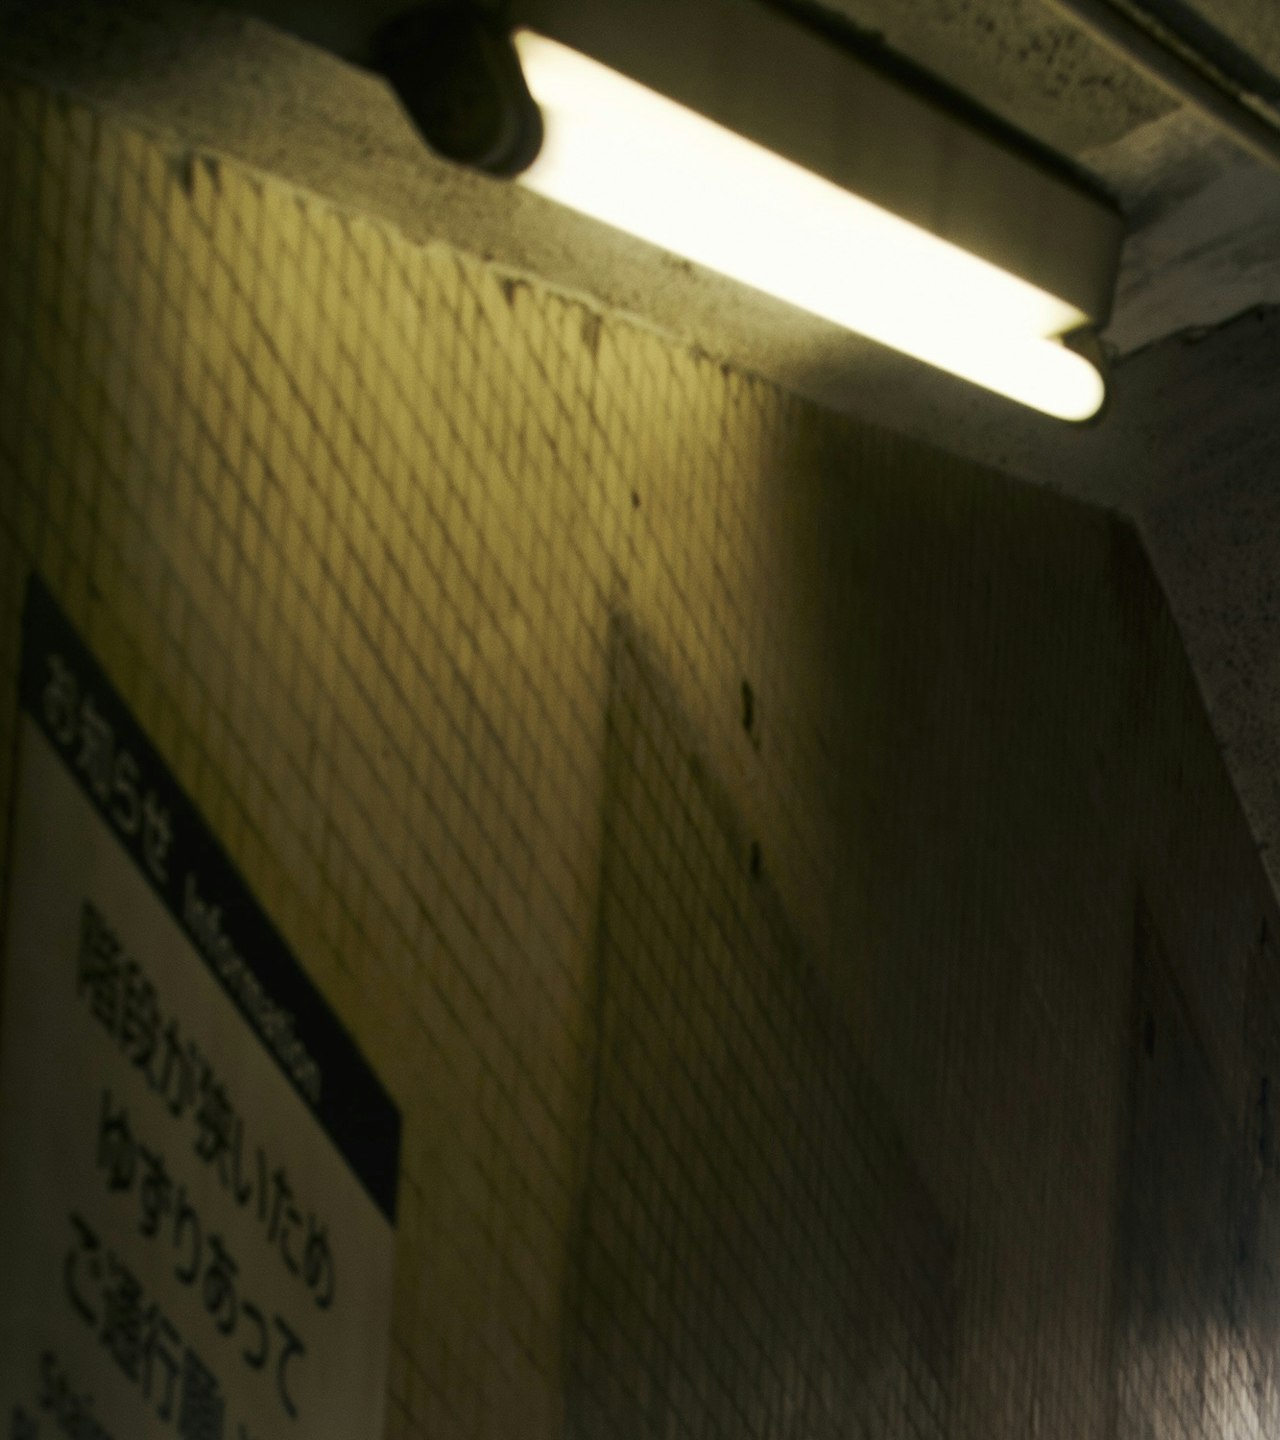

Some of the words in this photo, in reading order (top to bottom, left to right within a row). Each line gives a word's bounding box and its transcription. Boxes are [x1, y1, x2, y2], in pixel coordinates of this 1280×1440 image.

[43, 654, 174, 884] お知らせ
[76, 897, 335, 1312] 階段が狭いため
[96, 1089, 307, 1420] ゆずりあって
